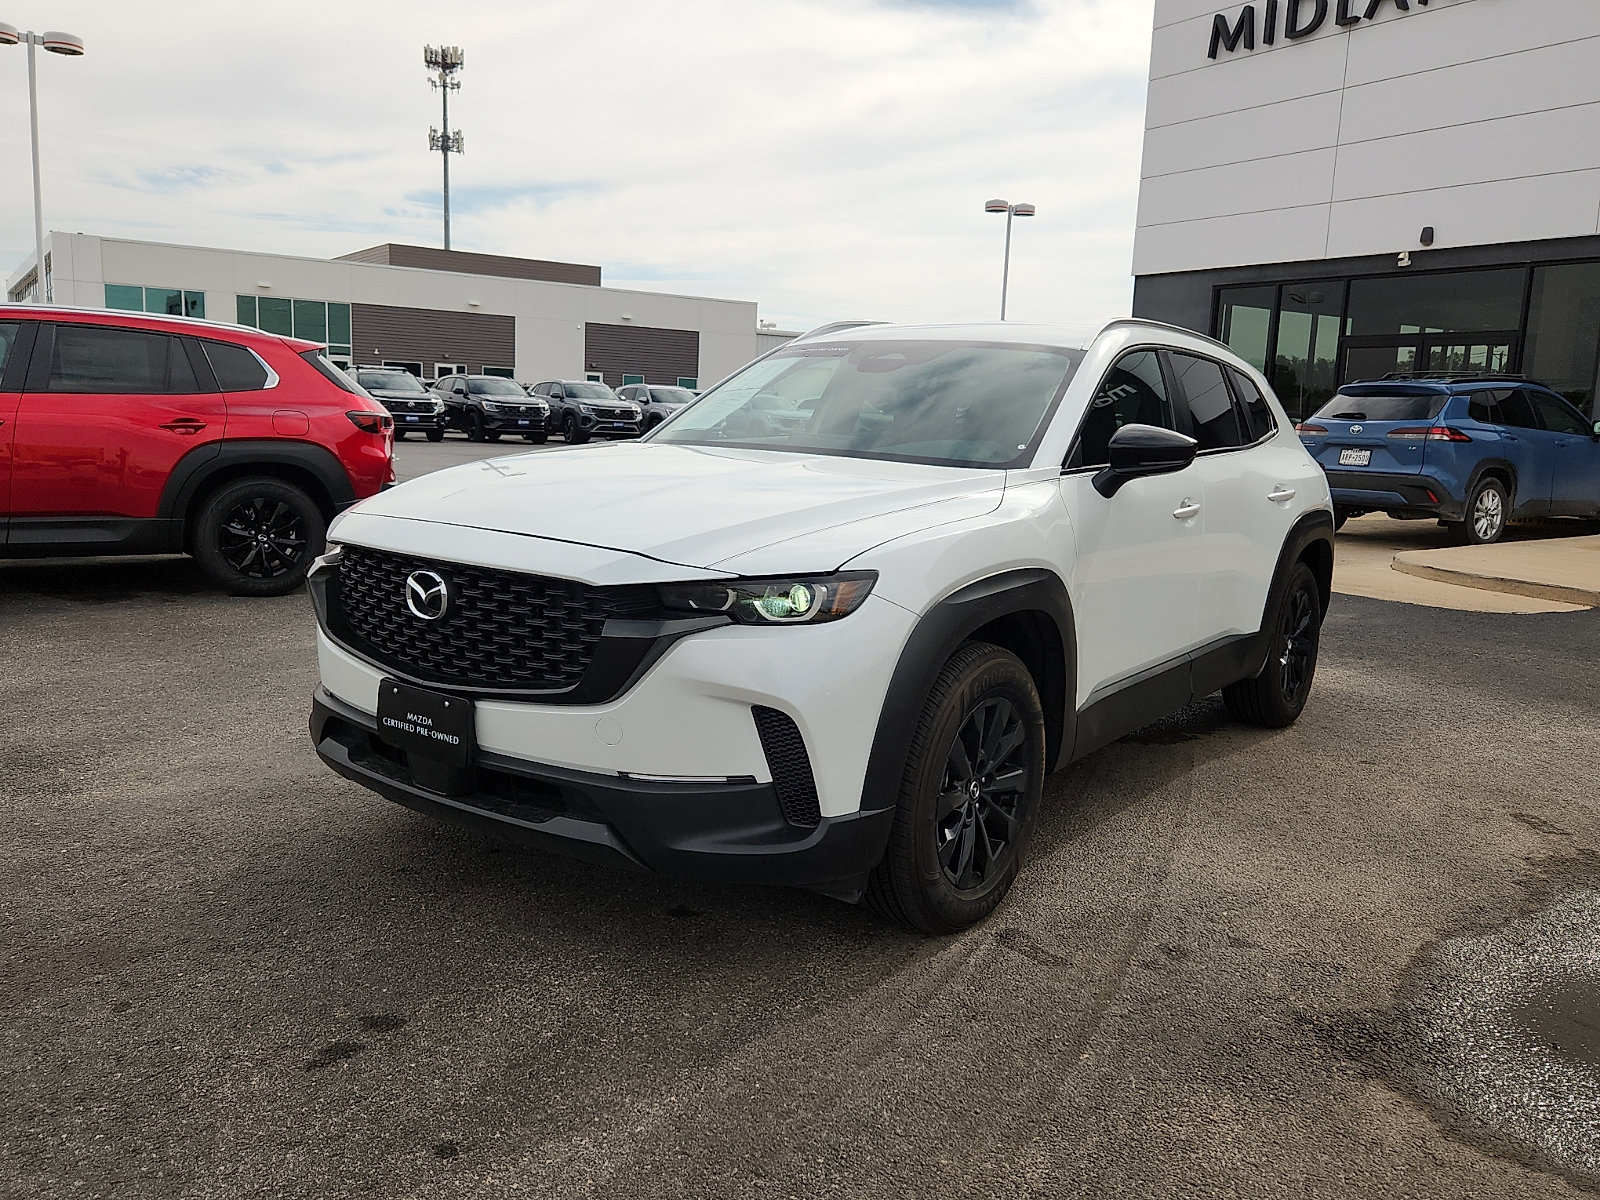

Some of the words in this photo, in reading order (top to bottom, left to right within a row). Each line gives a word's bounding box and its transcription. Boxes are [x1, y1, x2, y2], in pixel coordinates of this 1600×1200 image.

[1207, 0, 1428, 60] MIDL
[382, 716, 415, 733] CERTIFIED
[416, 726, 460, 745] PRE-OWNED
[406, 712, 433, 727] MAZDA
